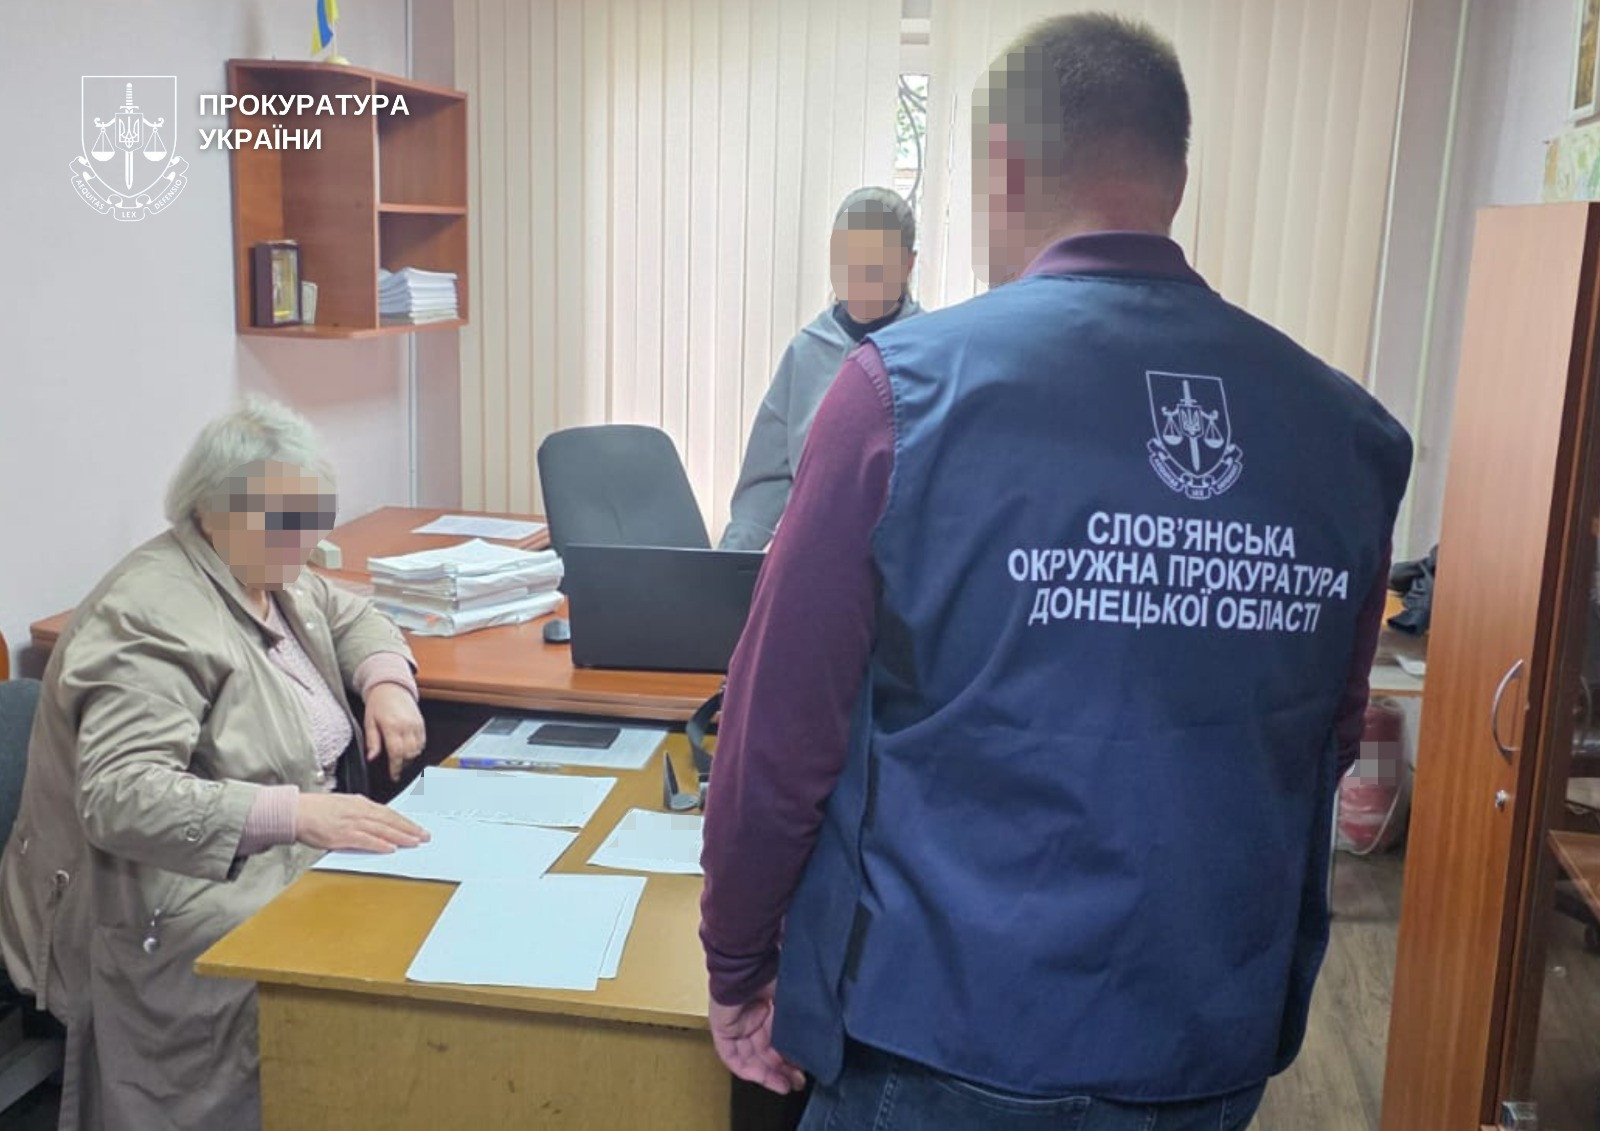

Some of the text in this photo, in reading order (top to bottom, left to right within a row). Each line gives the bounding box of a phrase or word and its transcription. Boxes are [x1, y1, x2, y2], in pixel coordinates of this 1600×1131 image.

[1008, 548, 1349, 600] ОКРУЖНА ПРОКУРАТУРА
[1028, 586, 1321, 633] ДОНЕЦЬКОЇ ОБЛАСТІ
